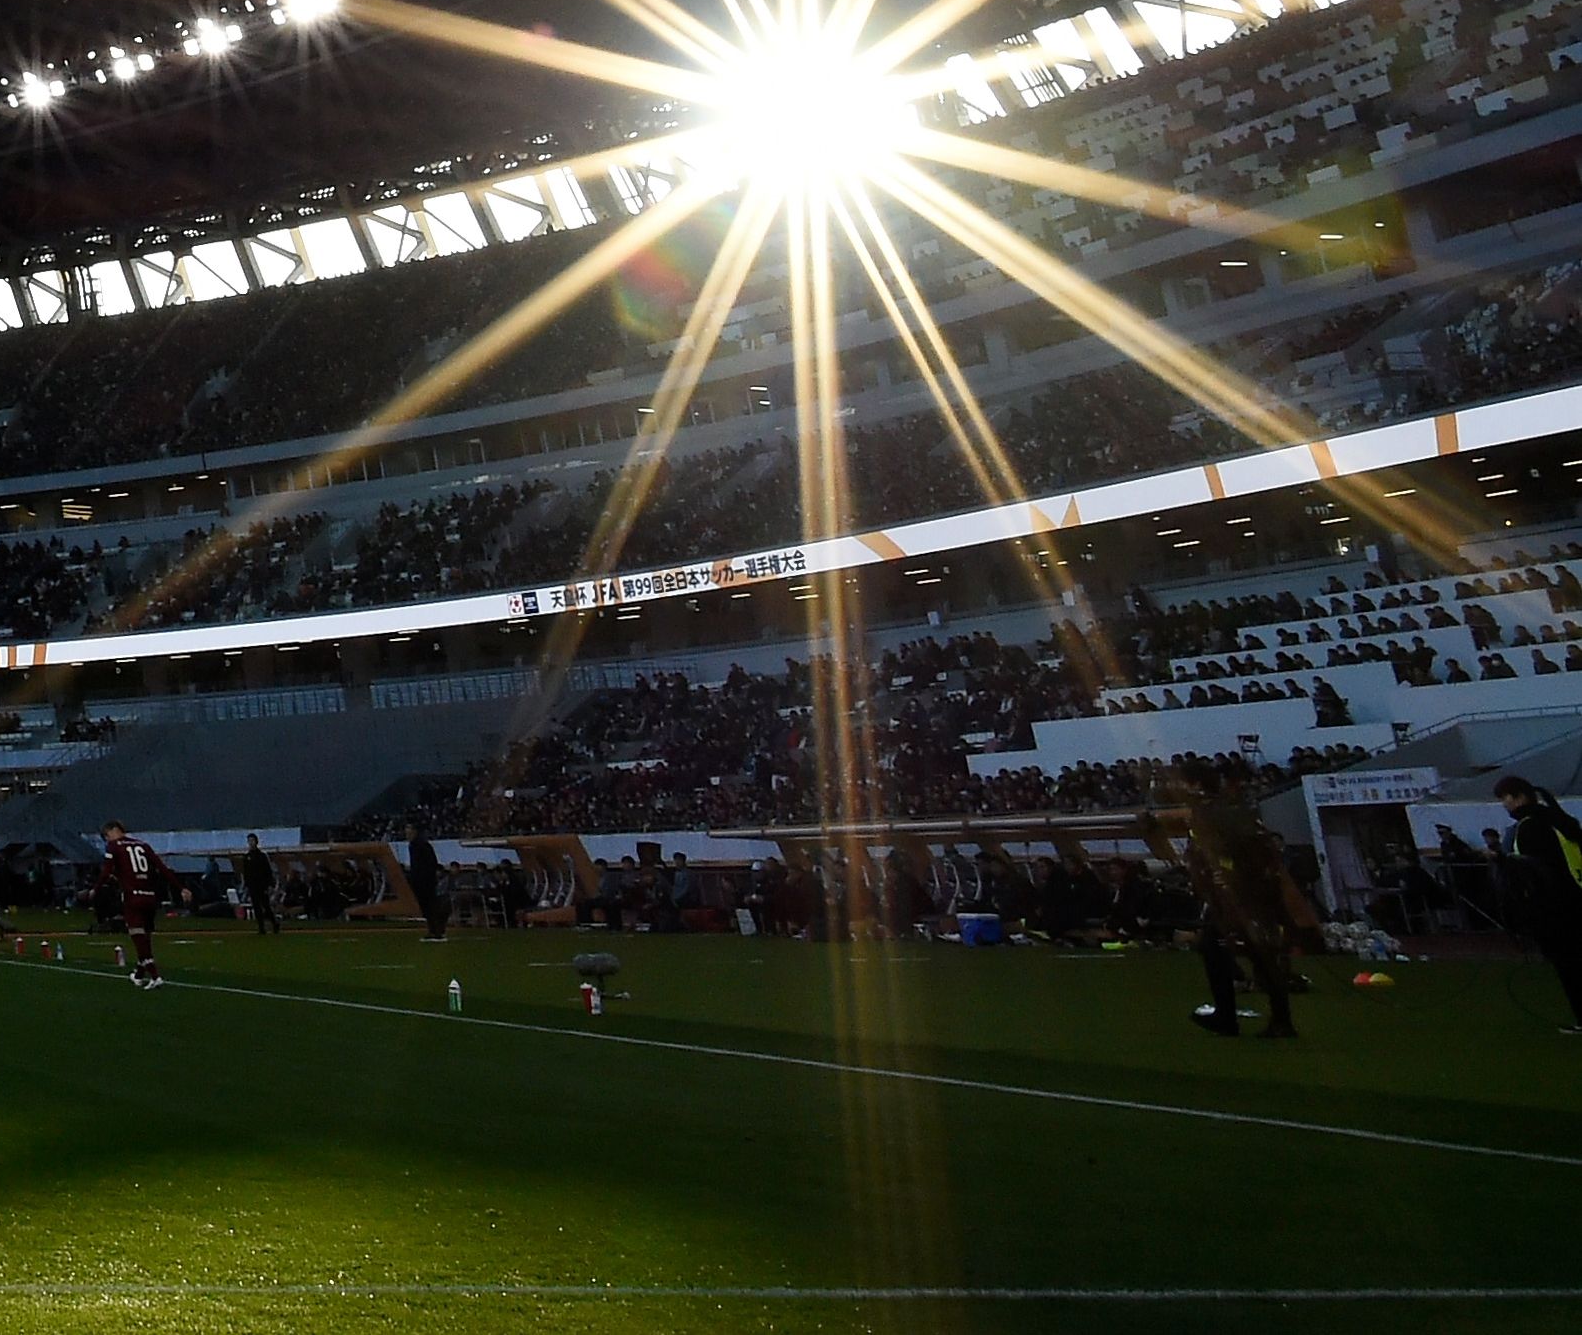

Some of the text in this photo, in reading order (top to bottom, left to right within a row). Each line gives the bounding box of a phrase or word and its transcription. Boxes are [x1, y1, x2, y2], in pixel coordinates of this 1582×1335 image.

[550, 550, 807, 609] 天皇杯 JFA 第99回全日本サッカー選手権大会
[126, 845, 149, 873] 16
